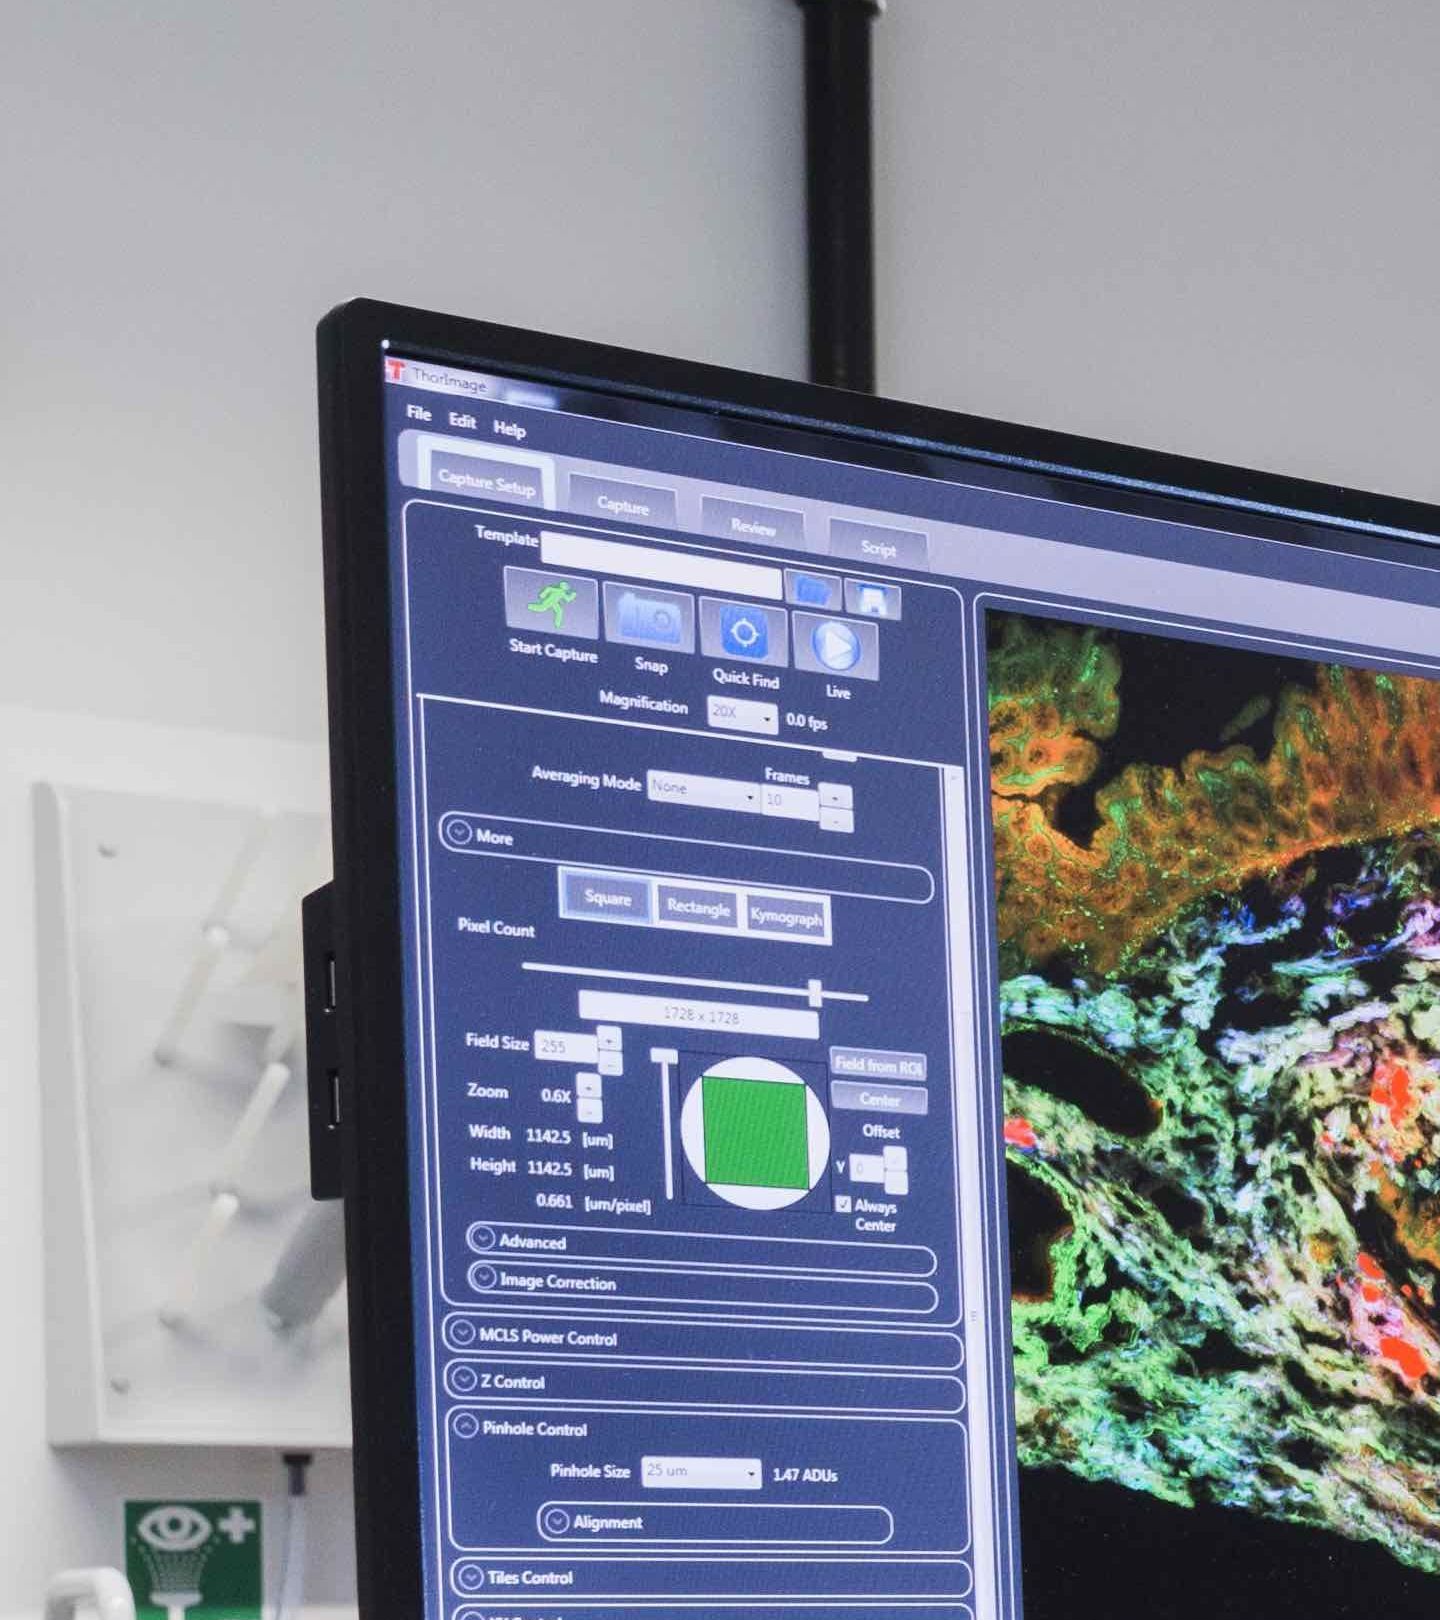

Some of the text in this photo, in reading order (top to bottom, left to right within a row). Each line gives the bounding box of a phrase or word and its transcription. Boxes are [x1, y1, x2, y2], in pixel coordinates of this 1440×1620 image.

[411, 367, 487, 395] ThorImage
[407, 405, 431, 423] File
[449, 411, 476, 430] Edit
[494, 418, 526, 440] Help
[439, 467, 536, 500] Capture Setup
[597, 495, 650, 517] Capture
[731, 517, 776, 537] Review
[475, 525, 539, 550] Template
[861, 538, 897, 559] Script
[509, 639, 598, 666] Start Capture
[635, 657, 668, 677] Snap
[713, 667, 780, 690] Quick Find
[826, 684, 851, 700] Live
[600, 691, 688, 715] Magnification
[712, 704, 737, 719] 20X
[787, 713, 827, 733] 0.0 fps
[532, 766, 642, 792] Averaging Mode
[765, 767, 810, 786] Frames
[653, 779, 687, 795] None
[476, 829, 514, 847] More
[585, 888, 632, 909] Square
[667, 898, 731, 921] Rectangle
[750, 906, 823, 931] Kymograph
[458, 917, 535, 939] Pixel Count
[466, 1033, 530, 1050] Field Size
[835, 1057, 865, 1072] Field
[869, 1059, 896, 1073] from
[467, 1084, 508, 1100] Zoom
[541, 1088, 571, 1105] 0.6X
[859, 1092, 900, 1108] Center
[468, 1125, 510, 1142] Width
[527, 1129, 613, 1149] 1142.5 [um]
[863, 1124, 900, 1140] Offset
[470, 1157, 516, 1176] Height
[528, 1161, 614, 1181] 1142.5 [um]
[536, 1194, 652, 1216] 0.661 [um/pixel]
[855, 1199, 897, 1216] Always
[855, 1218, 896, 1233] Center
[500, 1233, 567, 1250] Advanced
[501, 1272, 617, 1292] Image Correction
[480, 1327, 617, 1347] MCLS Power Control
[482, 1375, 545, 1389] Z Control
[483, 1420, 587, 1437] Pinhole Control
[551, 1463, 631, 1479] Pinhole Size
[648, 1463, 688, 1478] 25 um
[773, 1467, 838, 1483] 1.47 ADUs
[574, 1514, 643, 1533] Alignment
[488, 1570, 573, 1586] Tiles Control
